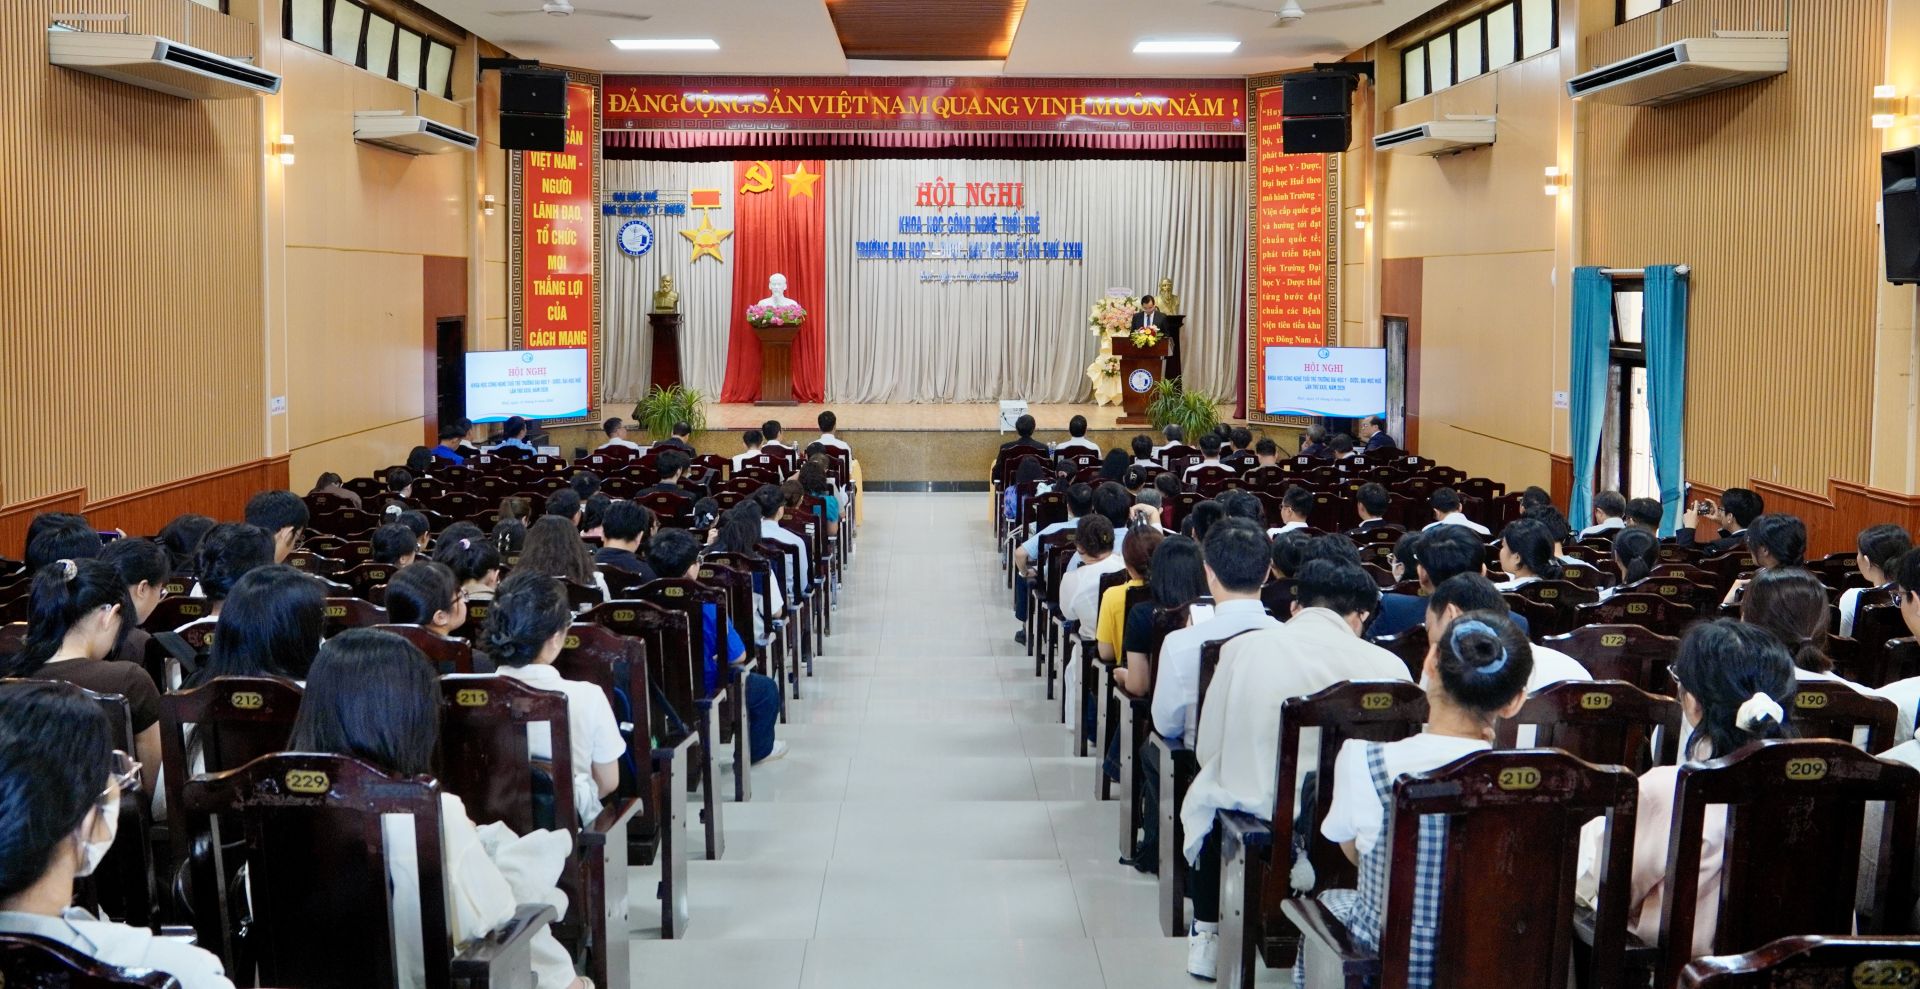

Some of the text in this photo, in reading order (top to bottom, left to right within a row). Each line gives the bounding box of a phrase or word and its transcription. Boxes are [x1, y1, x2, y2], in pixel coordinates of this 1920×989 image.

[608, 88, 1239, 118] ĐẢNG CỘNG SẢN VIỆT NAM QUANG VINH MUÔN NĂM !
[554, 154, 577, 170] NAM
[541, 176, 572, 195] NGƯỜI
[916, 176, 1025, 212] HỘI NGHỊ
[533, 201, 560, 219] LÃNH
[536, 224, 577, 246] TỔ CHỨC
[547, 255, 567, 273] MỌI
[533, 275, 583, 299] THẮNG LỢI
[547, 301, 568, 321] CỦA
[529, 328, 587, 349] CÁCH MẠNG
[1603, 636, 1625, 646] 172
[235, 694, 260, 705] 212
[460, 691, 484, 705] 211
[1366, 694, 1390, 708] 192
[1586, 694, 1610, 708] 191
[1801, 693, 1824, 707] 190
[1790, 761, 1822, 776] 209
[290, 773, 325, 789] 229
[1502, 771, 1537, 786] 210
